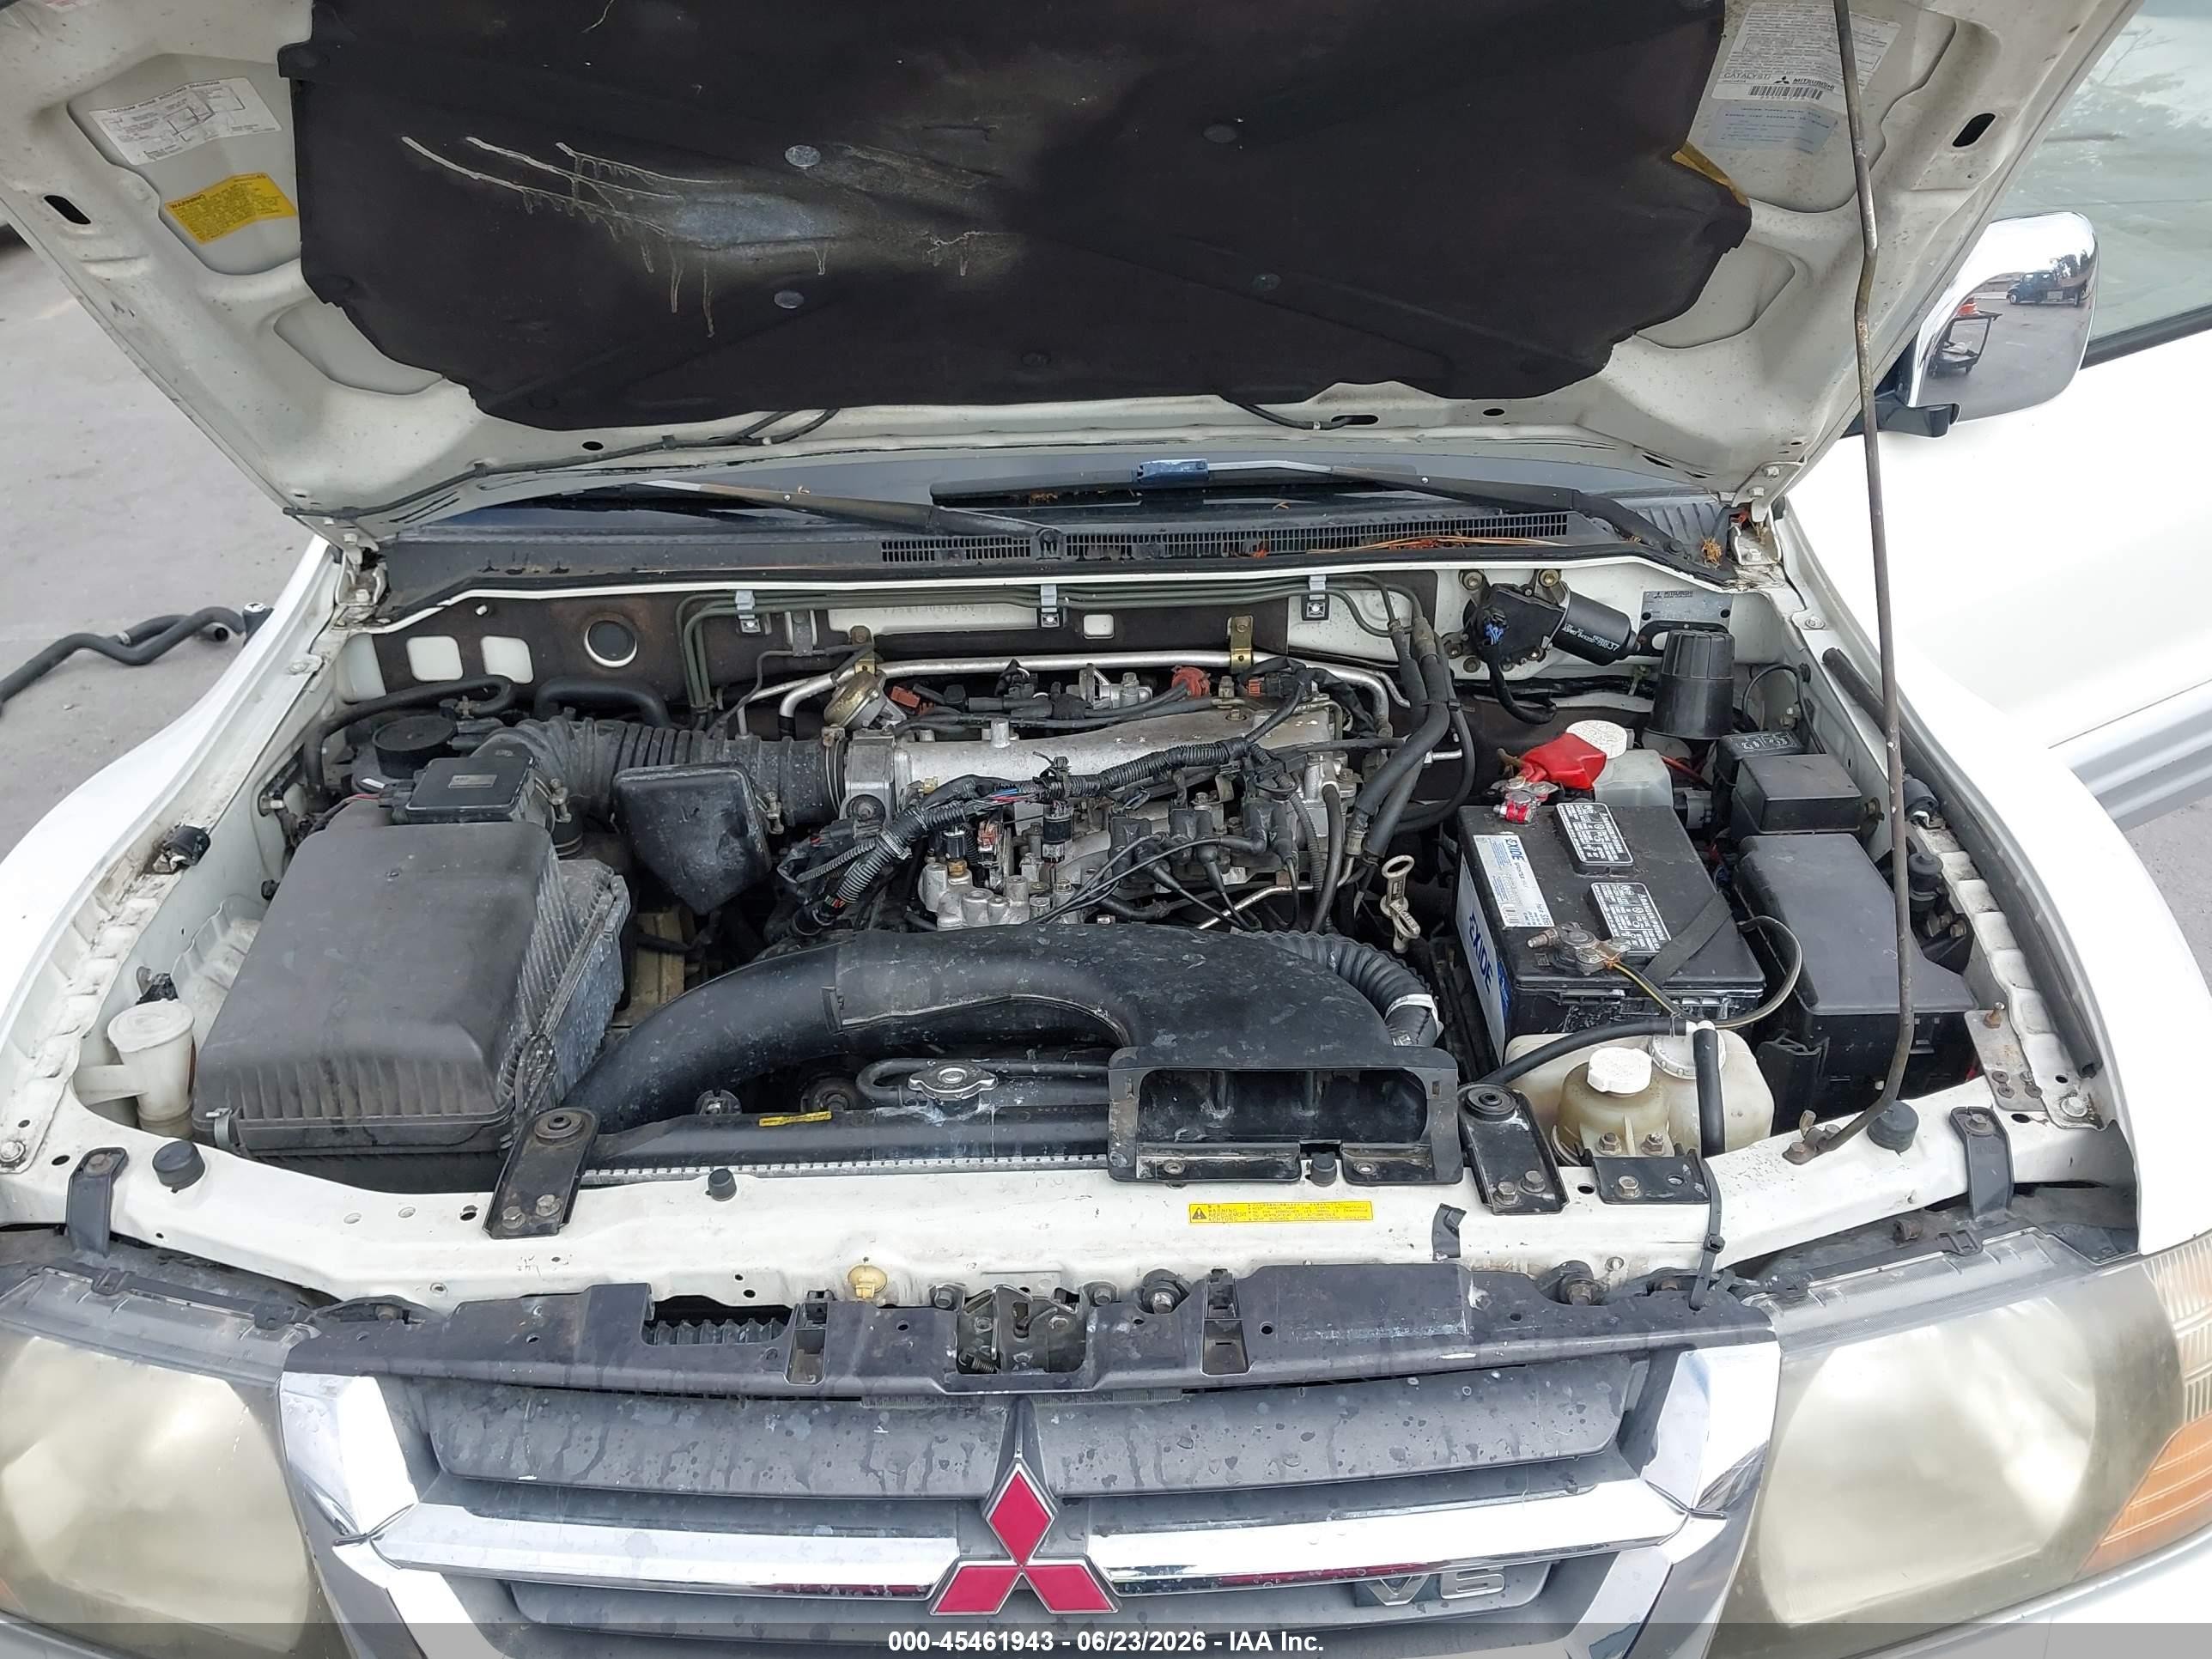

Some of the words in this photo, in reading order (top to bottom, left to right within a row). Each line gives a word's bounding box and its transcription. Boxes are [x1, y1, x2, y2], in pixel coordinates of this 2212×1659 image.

[1791, 77, 1835, 91] MITSUBISHI
[1504, 837, 1526, 862] EXIDE
[1468, 911, 1494, 995] EXIDE
[1365, 1565, 1504, 1607] V6
